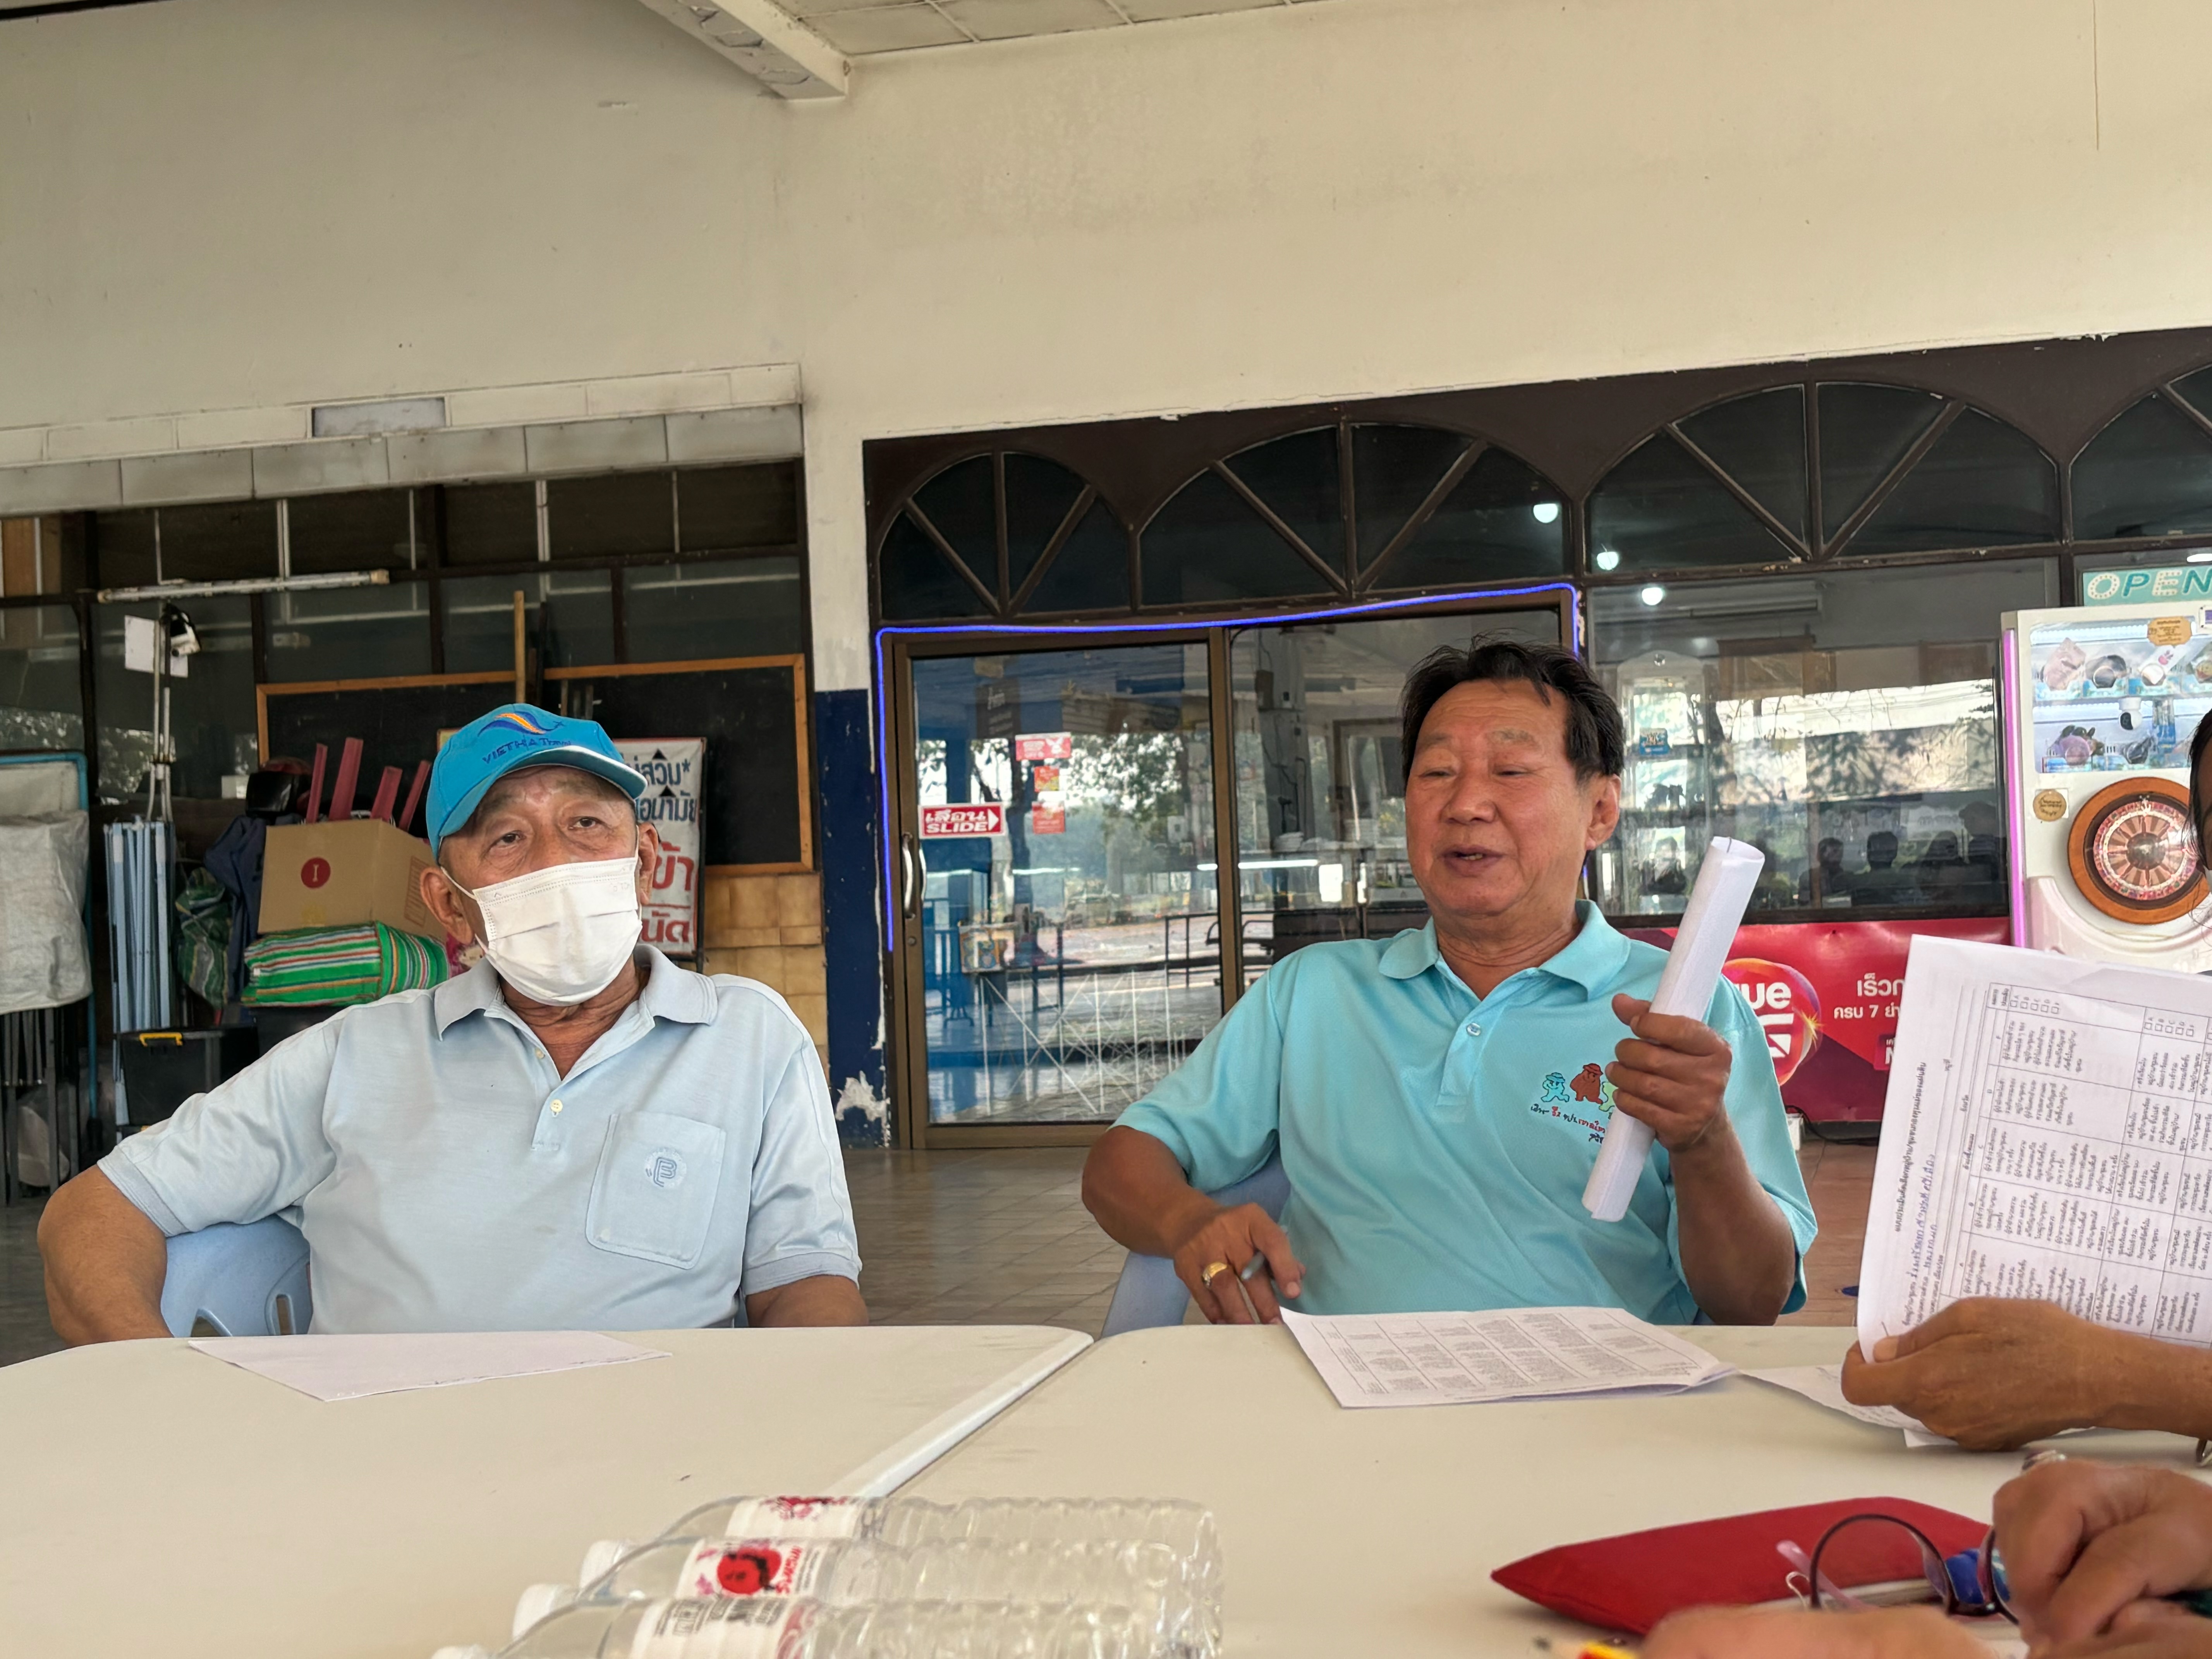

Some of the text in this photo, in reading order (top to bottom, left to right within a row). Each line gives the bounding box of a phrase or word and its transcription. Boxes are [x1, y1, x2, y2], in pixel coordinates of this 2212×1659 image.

[2088, 567, 2212, 600] OPEN
[635, 790, 697, 822] อนามัย
[926, 821, 988, 833] SLIDE
[653, 842, 694, 891] ข้า
[1738, 982, 1792, 1010] ue
[1834, 1006, 1863, 1019] ครบ
[1869, 1004, 1879, 1018] 7
